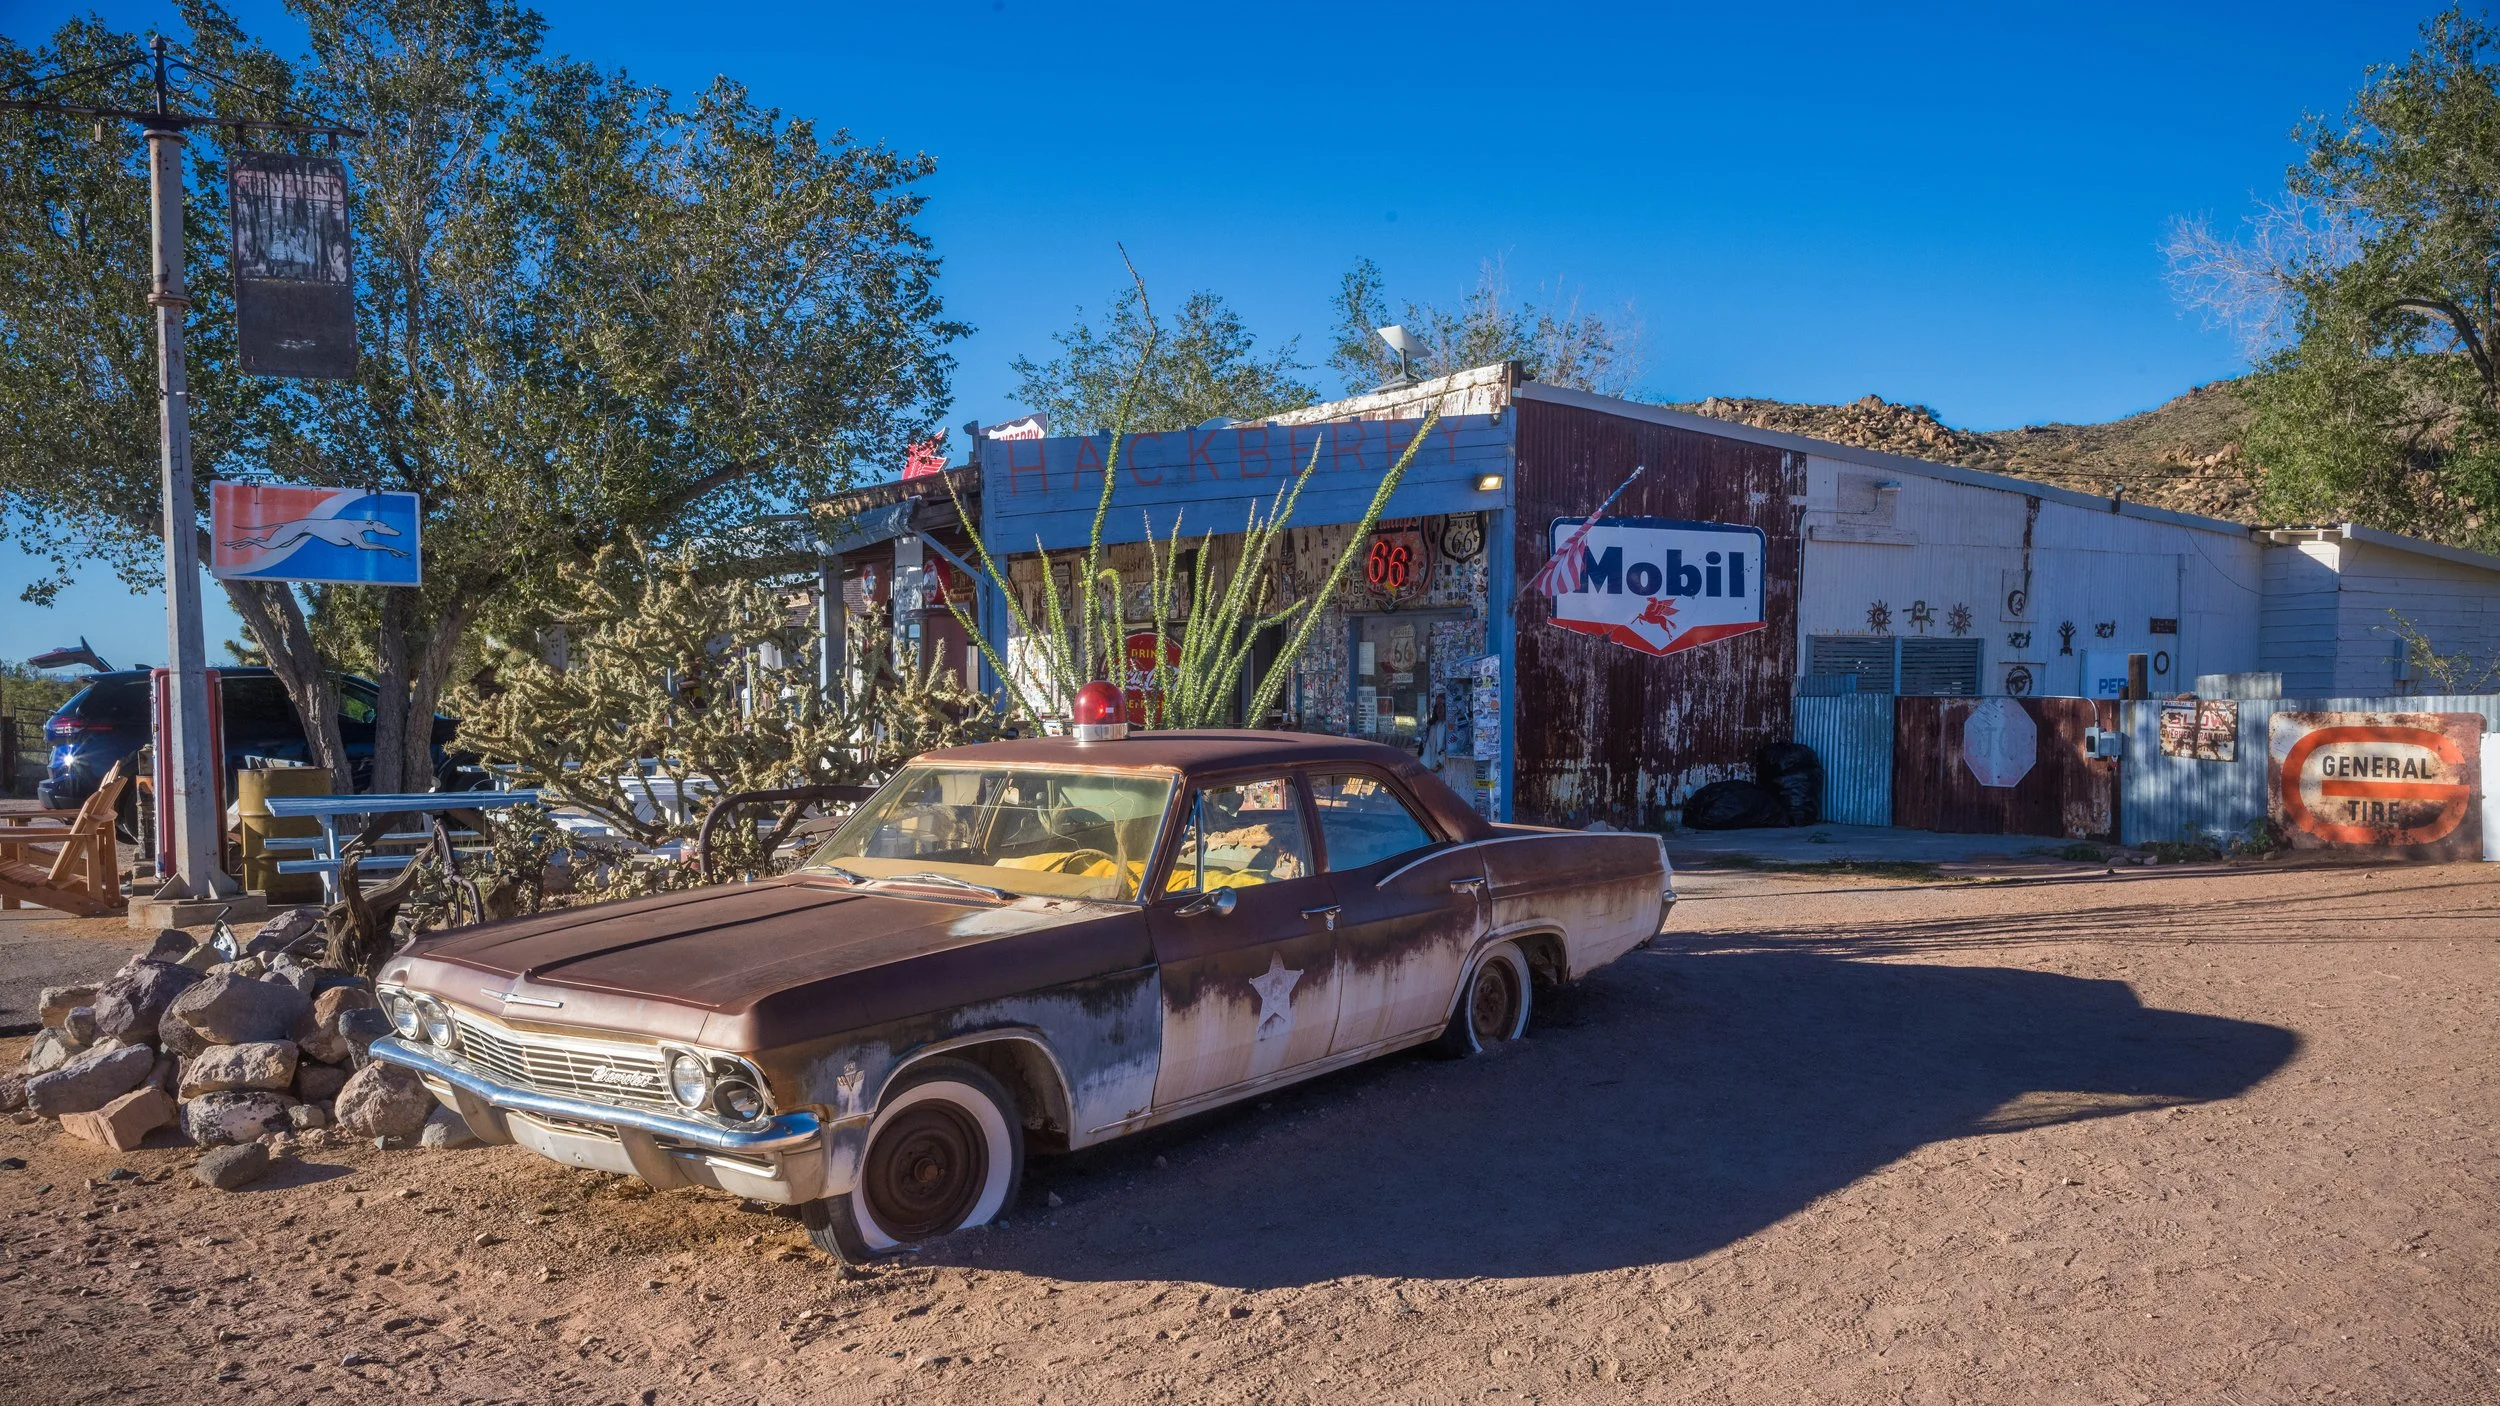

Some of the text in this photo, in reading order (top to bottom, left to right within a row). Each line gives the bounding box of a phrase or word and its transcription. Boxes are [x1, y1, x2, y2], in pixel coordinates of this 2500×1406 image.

[1007, 416, 1465, 497] HACKBERRY
[1452, 530, 1472, 554] 66
[1369, 541, 1411, 588] 66
[1574, 546, 1746, 598] Mobil
[1131, 648, 1160, 659] DRIN
[2169, 712, 2227, 728] SLOW
[2161, 728, 2195, 741] OVERHEA
[2322, 755, 2433, 779] GENERAL
[2347, 800, 2401, 823] TIRE
[591, 1064, 654, 1088] Chevrolet
